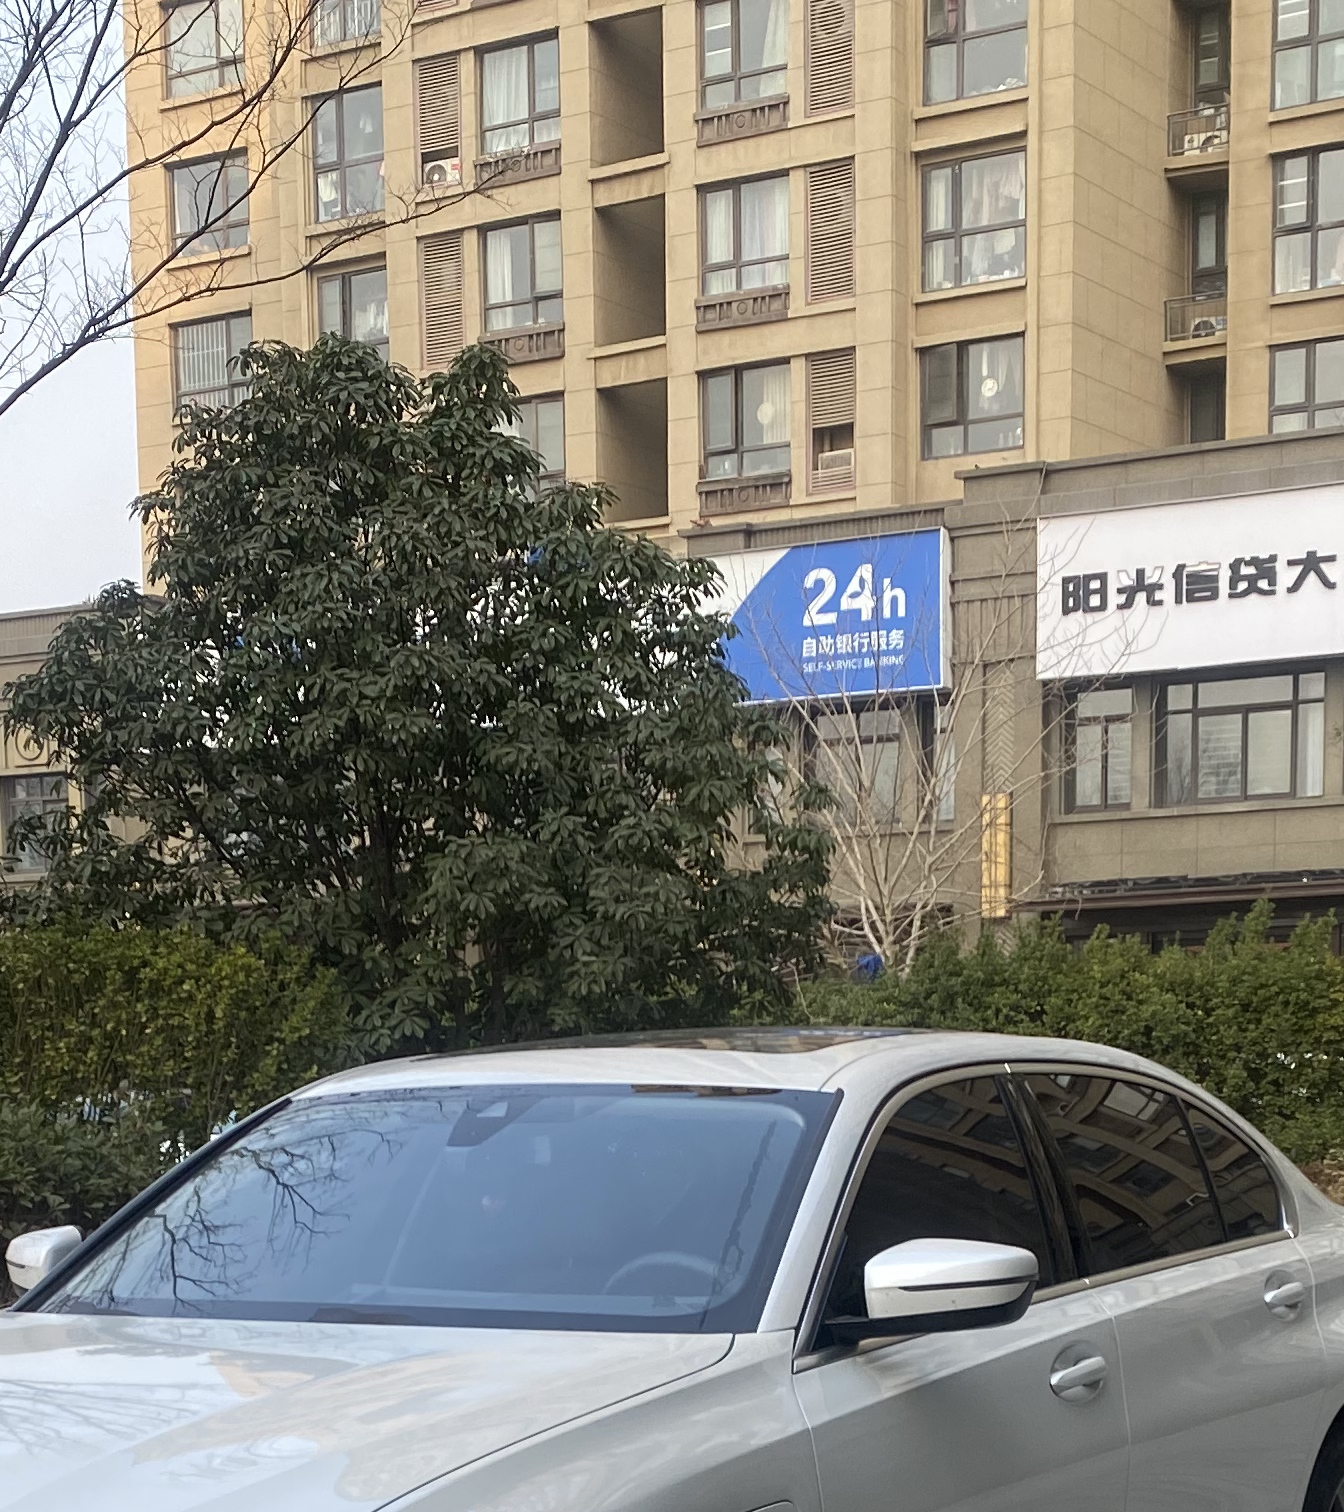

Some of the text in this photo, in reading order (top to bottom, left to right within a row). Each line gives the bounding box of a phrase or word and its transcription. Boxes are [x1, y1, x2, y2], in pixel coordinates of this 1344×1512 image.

[802, 563, 906, 627] 24h
[802, 628, 905, 657] 自助银行服务
